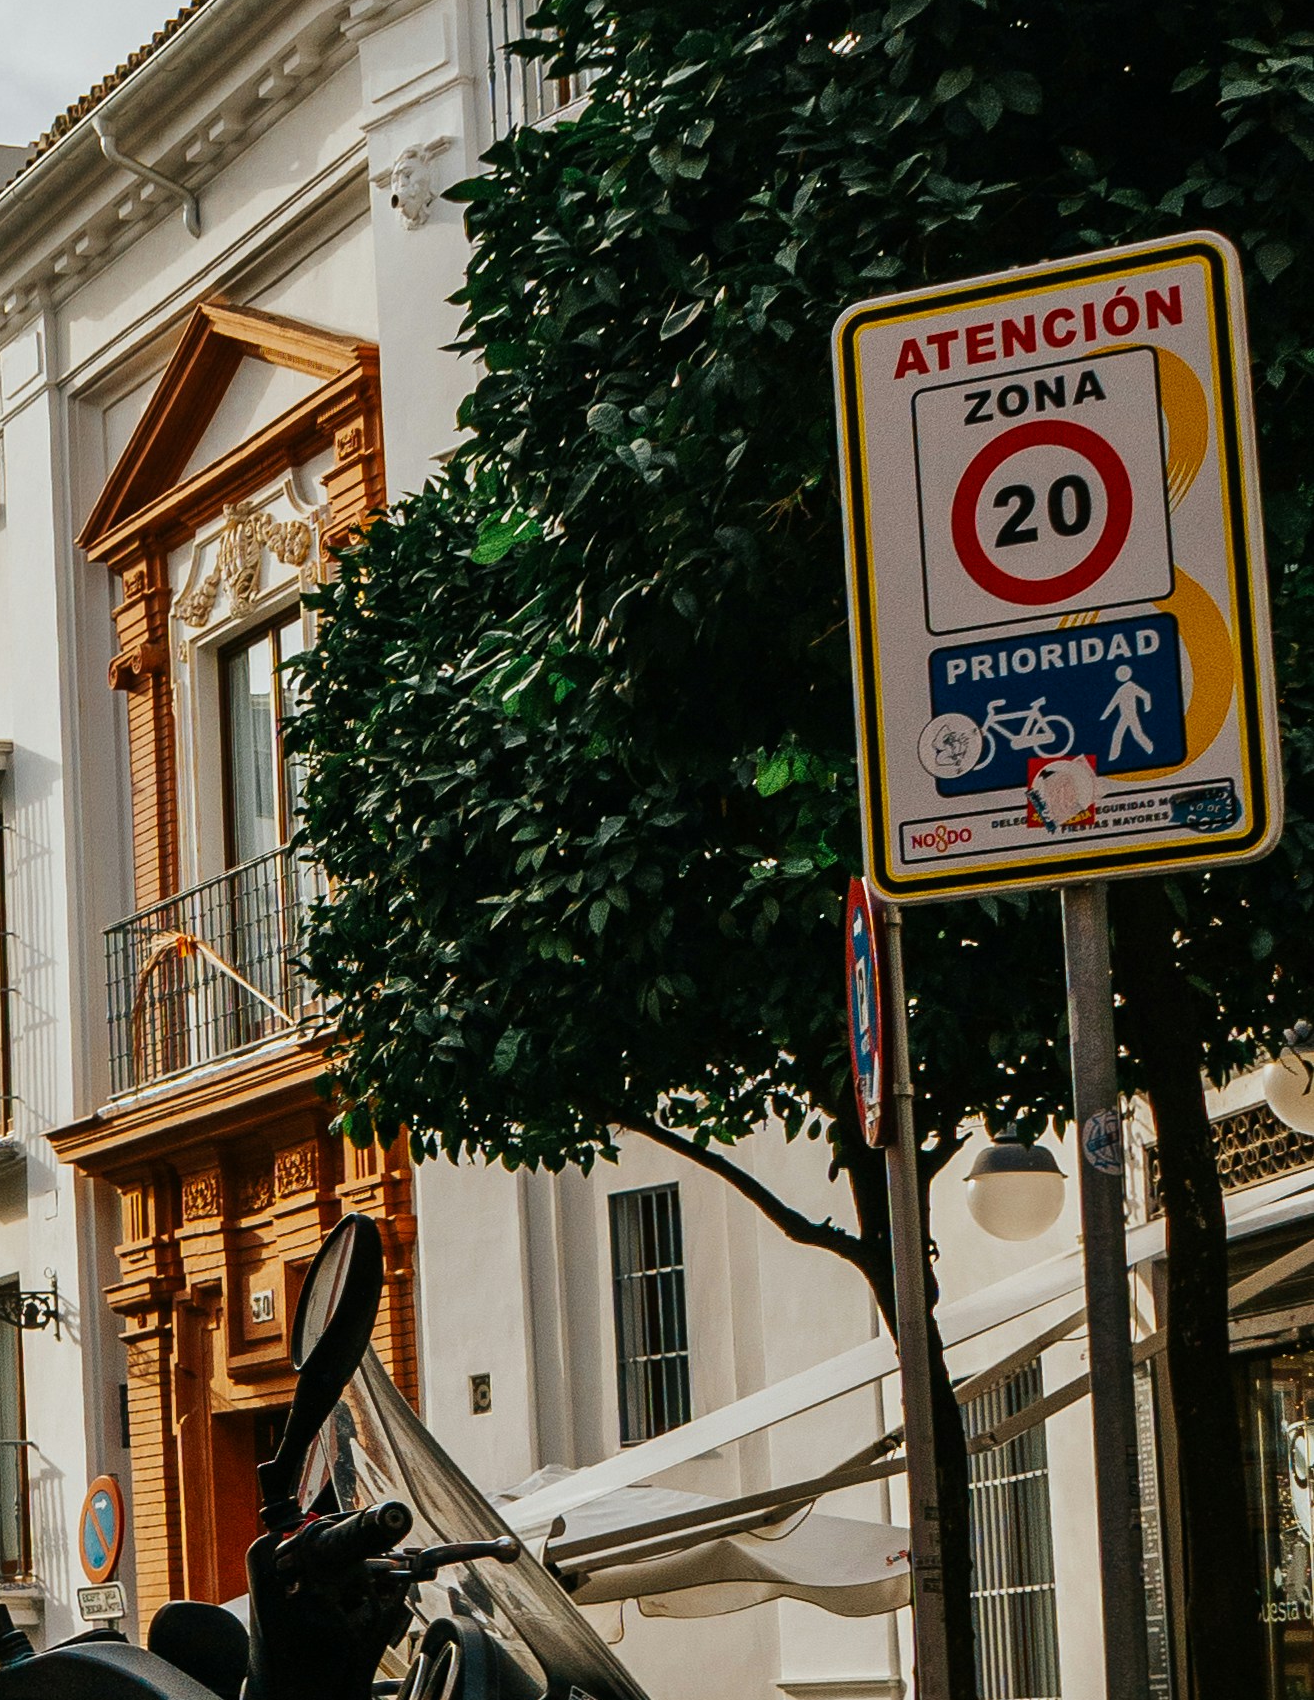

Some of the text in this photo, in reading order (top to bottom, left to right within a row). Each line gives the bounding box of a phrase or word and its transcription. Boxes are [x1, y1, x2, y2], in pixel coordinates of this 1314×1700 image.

[893, 286, 1184, 380] ATENCIÓN
[963, 369, 1107, 427] ZONA
[992, 474, 1093, 549] 20
[946, 628, 1161, 686] PRIORIDAD
[1094, 799, 1155, 815] EGURIDAD
[1112, 811, 1170, 827] MAYORES
[252, 1295, 270, 1320] 30
